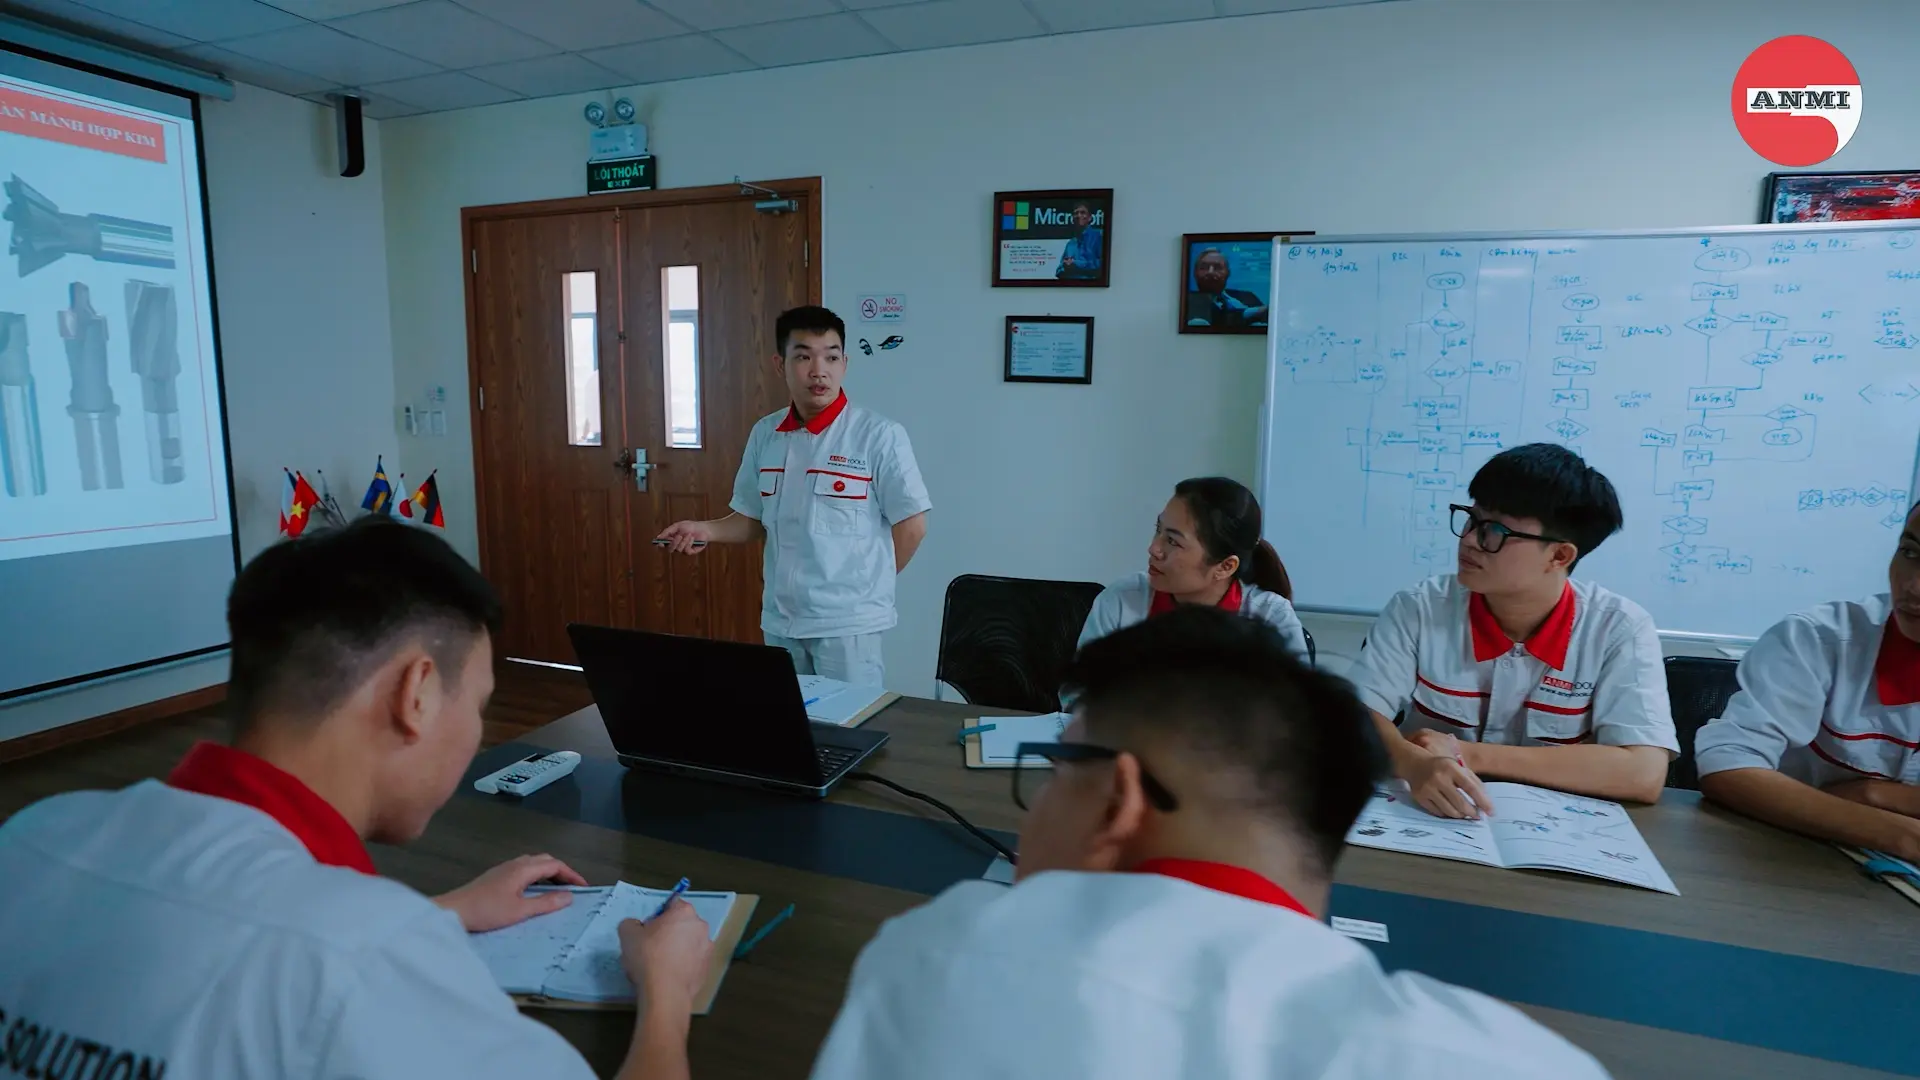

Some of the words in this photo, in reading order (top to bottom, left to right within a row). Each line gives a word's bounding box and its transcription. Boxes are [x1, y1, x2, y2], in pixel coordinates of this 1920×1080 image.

[124, 131, 157, 148] KIM
[611, 163, 645, 178] THOÁT
[1034, 206, 1104, 226] Microft
[885, 297, 897, 305] NO
[879, 305, 904, 313] SMOKING
[1544, 677, 1573, 690] ANMI
